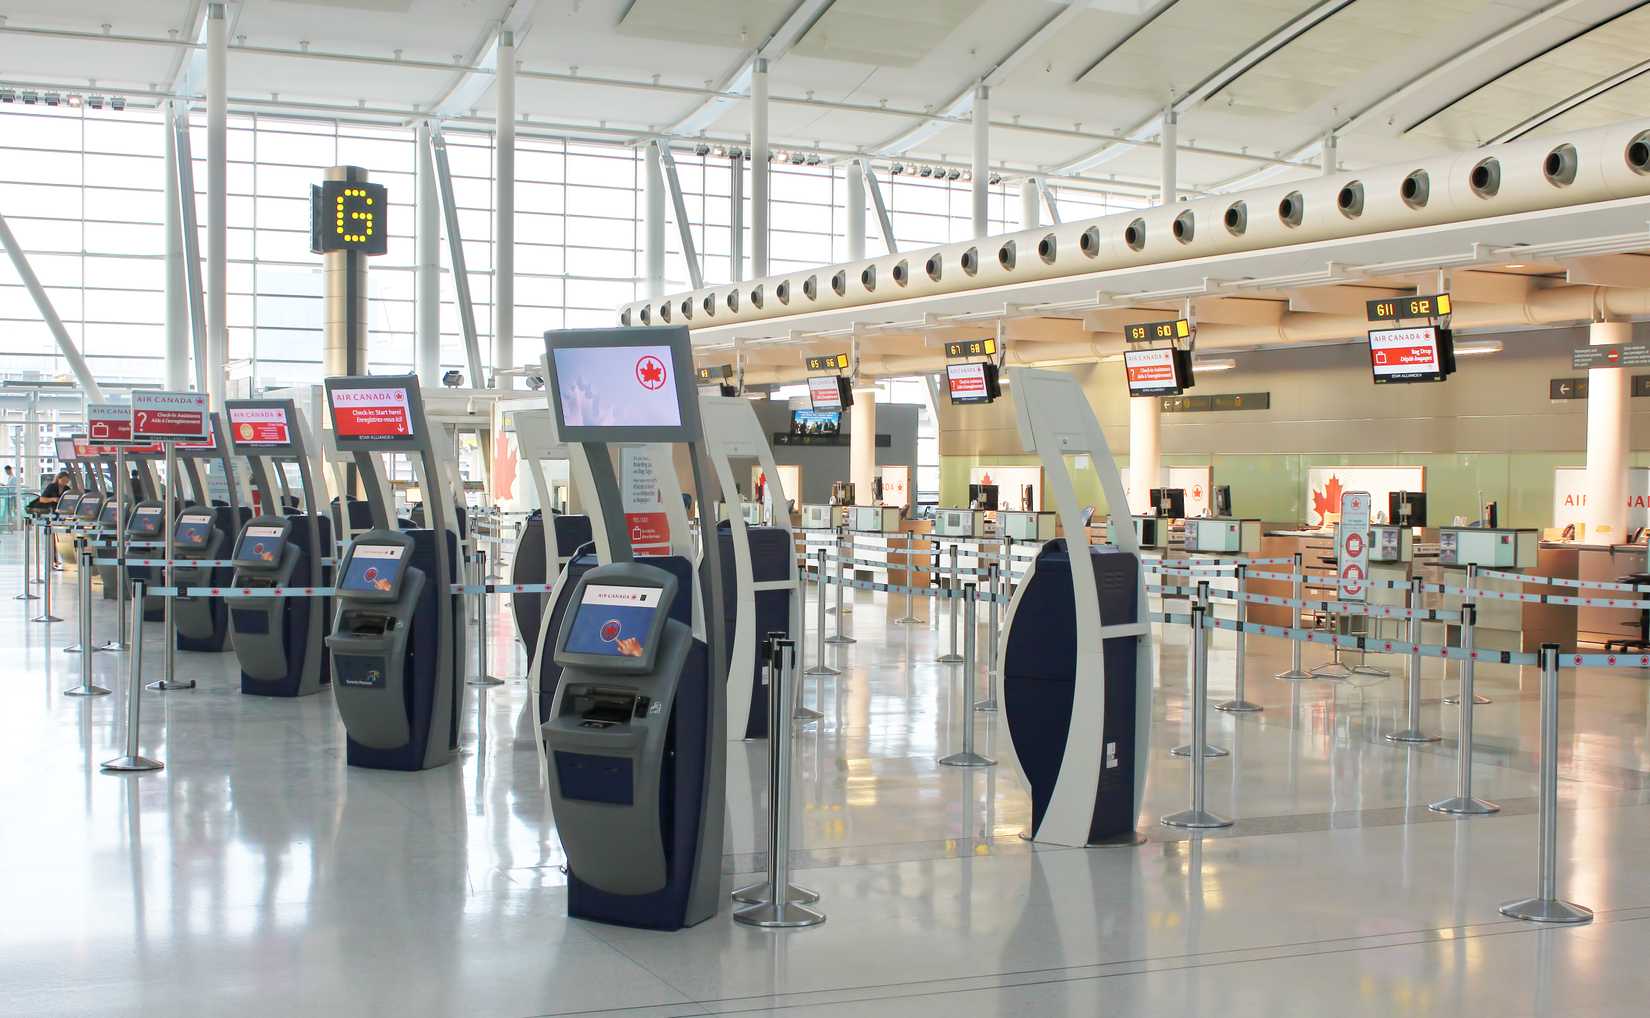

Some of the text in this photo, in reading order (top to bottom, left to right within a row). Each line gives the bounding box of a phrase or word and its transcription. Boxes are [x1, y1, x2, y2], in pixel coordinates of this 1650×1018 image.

[337, 189, 373, 242] G
[1376, 303, 1394, 316] G11
[1388, 333, 1421, 342] CANADA
[137, 395, 192, 404] AIR CANADA
[336, 393, 391, 401] AIR CANADA
